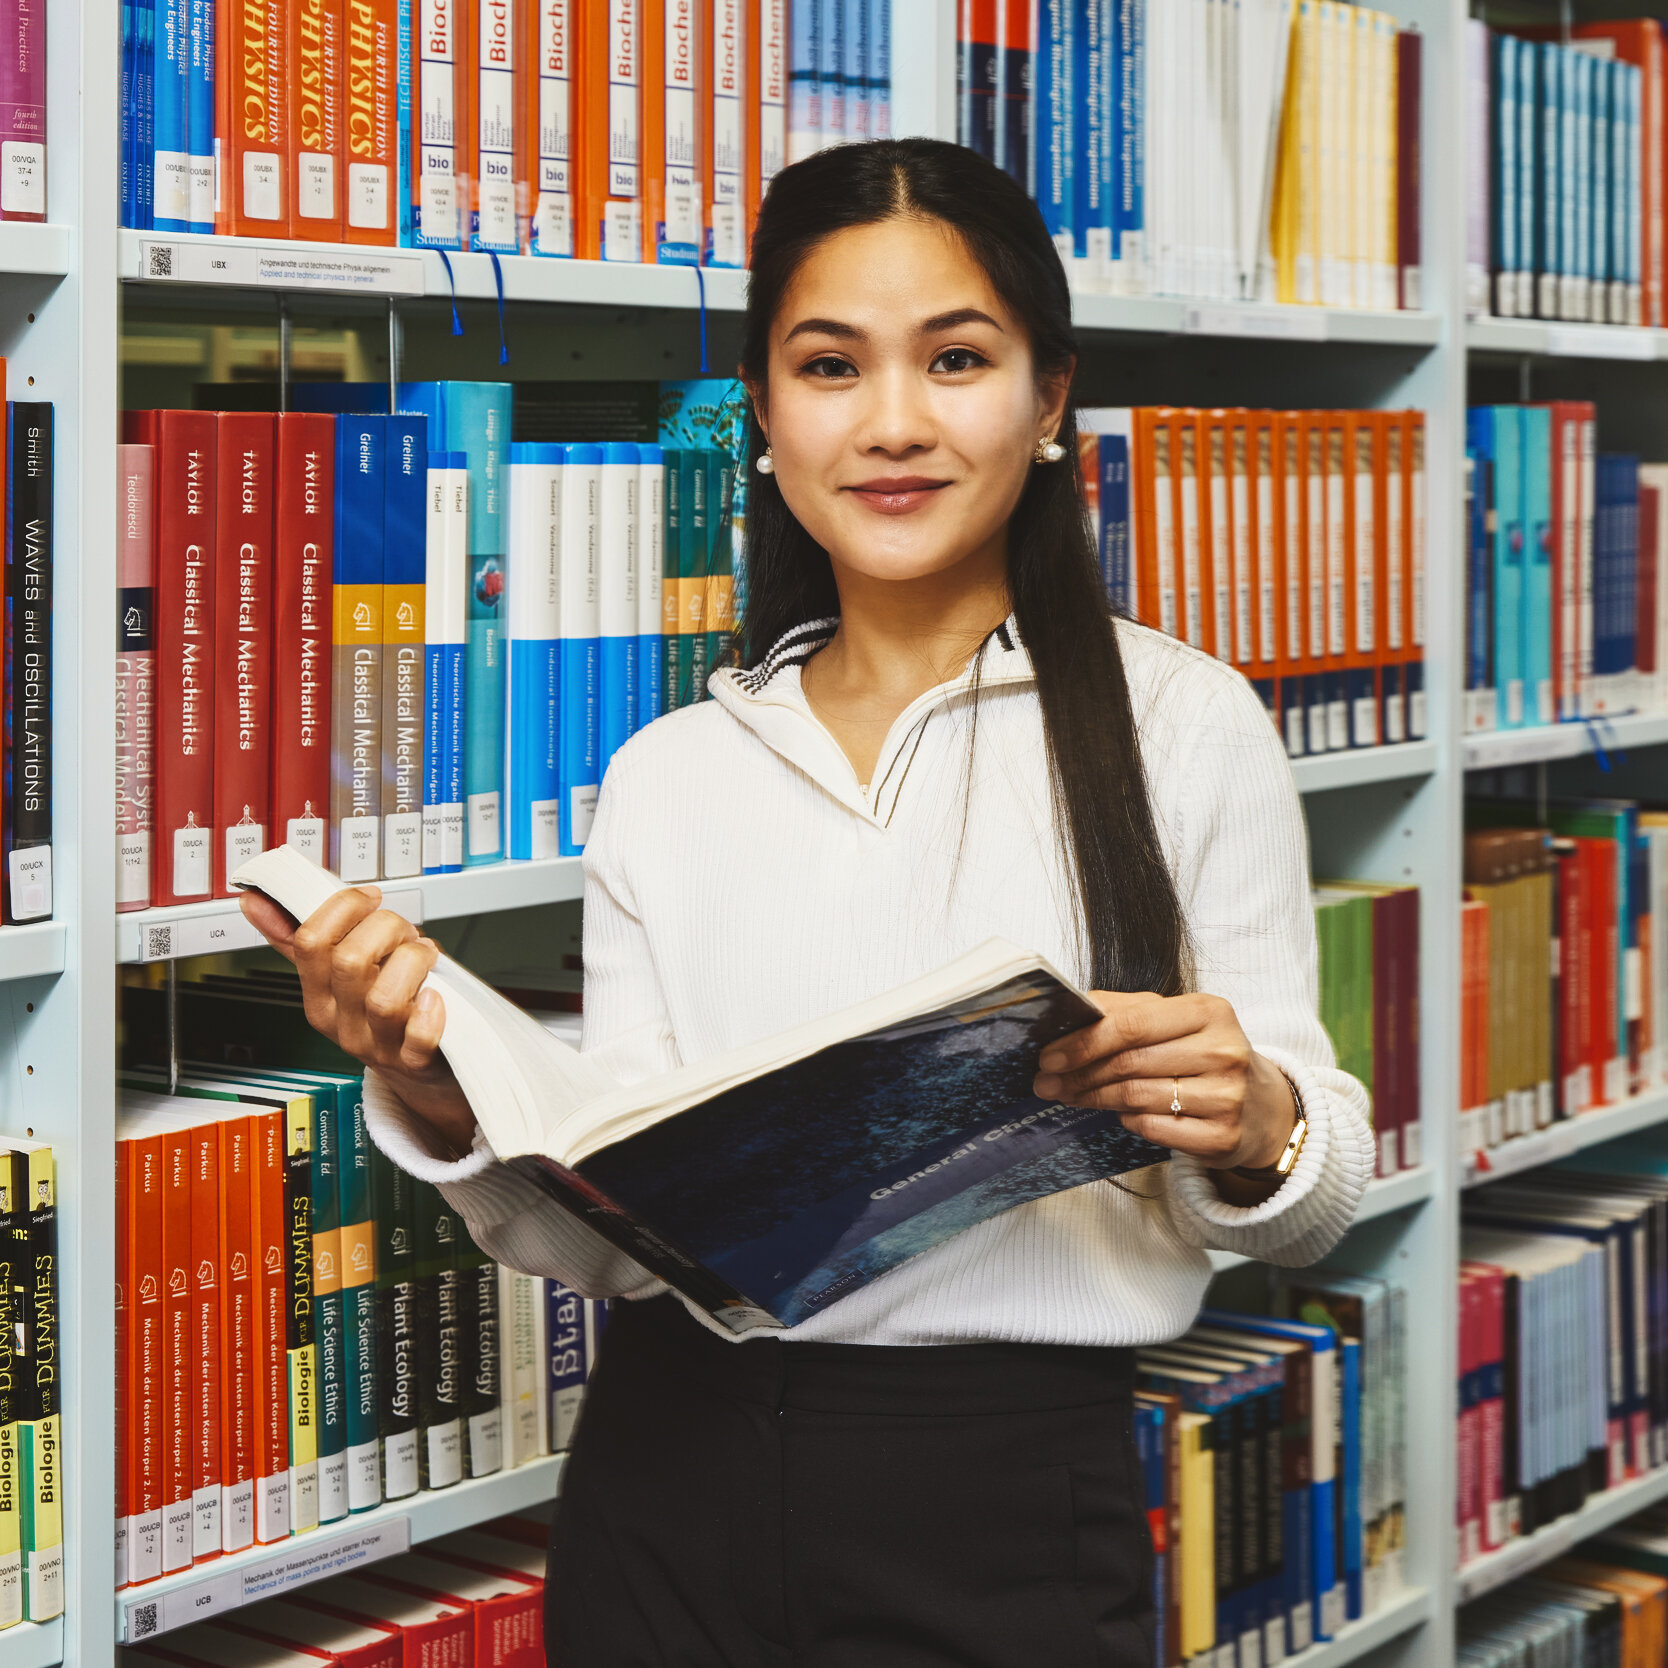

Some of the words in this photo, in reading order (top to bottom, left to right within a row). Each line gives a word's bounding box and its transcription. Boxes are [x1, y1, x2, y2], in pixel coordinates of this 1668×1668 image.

[19, 16, 28, 72] Practices
[166, 10, 174, 60] Engineers
[192, 18, 202, 66] Engineers
[268, 1, 277, 71] FOURTH
[324, 11, 334, 80] FOURTH
[376, 21, 386, 89] FOURTH
[548, 0, 562, 70] Bioch
[244, 0, 265, 143] HYSICS
[301, 0, 322, 150] PHYSICS
[350, 0, 372, 158] PHYSICS
[400, 22, 410, 111] TECHNISCHE
[14, 108, 36, 119] fourth
[14, 120, 38, 130] edition
[268, 75, 278, 146] EDITION
[324, 84, 334, 153] EDITION
[376, 93, 386, 160] EDITION
[12, 156, 36, 164] 00/VQA
[428, 155, 448, 168] bio
[487, 162, 508, 174] bio
[546, 168, 564, 181] bio
[212, 261, 226, 269] UBX
[260, 258, 298, 268] Angewandte
[310, 261, 342, 270] technische
[344, 263, 362, 273] Physik
[260, 269, 282, 280] Applied
[28, 427, 38, 477] Smith
[360, 433, 370, 474] Greiner
[403, 435, 414, 475] Greiner
[128, 474, 138, 539] Teodorescu
[188, 450, 198, 514] TAYLOR
[242, 450, 252, 514] TAYLOR
[305, 452, 314, 514] TAYLOR
[26, 520, 38, 600] WAVES
[302, 543, 318, 630] Classical
[184, 545, 200, 634] Classical
[239, 543, 254, 632] Classical
[25, 610, 37, 644] and
[116, 658, 131, 747] Classical
[182, 643, 198, 755] Mechanics
[238, 640, 254, 750] Mechanics
[301, 638, 316, 747] Mechanics
[354, 649, 372, 724] Classical
[397, 648, 414, 722] Classical
[25, 653, 38, 812] OSCILLATIONS
[136, 658, 149, 778] Mechanical
[353, 730, 371, 817] Mechanic
[396, 728, 414, 812] Mechanic
[432, 757, 436, 766] in
[115, 755, 131, 832] Models
[20, 860, 44, 871] 00/UCX
[236, 836, 256, 845] 00/UCA
[210, 930, 226, 938] UCA
[320, 1110, 328, 1156] Comstock
[354, 1103, 362, 1148] Comstock
[869, 1142, 978, 1201] General
[982, 1103, 1070, 1142] Chem
[321, 1162, 330, 1176] Ed.
[356, 1155, 364, 1168] Ed.
[32, 1212, 54, 1224] Siegfried
[292, 1196, 310, 1318] DUMMIES
[323, 1299, 335, 1324] Life
[358, 1289, 369, 1316] Life
[394, 1282, 408, 1336] Plant
[439, 1270, 452, 1323] Plant
[478, 1263, 492, 1315] Plant
[34, 1254, 54, 1388] DUMMIES
[358, 1318, 370, 1370] Science
[324, 1327, 336, 1380] Science
[392, 1339, 410, 1417] Ecology
[437, 1327, 453, 1404] Ecology
[476, 1320, 493, 1395] Ecology
[298, 1350, 311, 1426] Biologie
[325, 1383, 338, 1426] Ethics
[360, 1373, 372, 1415] Ethics
[39, 1421, 55, 1504] Biologie
[173, 1430, 182, 1468] Körper
[201, 1420, 210, 1458] Körper
[0, 1430, 14, 1512] Biologie
[169, 1512, 190, 1524] 00/UCB
[196, 1500, 217, 1512] 00/UCB
[39, 1558, 61, 1572] 00/VNO
[44, 1572, 58, 1582] 2+11
[244, 1571, 274, 1584] Mechanik
[274, 1566, 284, 1576] der
[286, 1553, 328, 1572] Massenpunkte
[330, 1549, 341, 1558] und
[362, 1535, 382, 1547] Körper
[244, 1580, 278, 1595] Mechanics
[278, 1576, 285, 1585] of
[286, 1572, 301, 1582] mass
[302, 1566, 320, 1577] points
[322, 1562, 333, 1571] and
[334, 1556, 346, 1568] rigid
[348, 1550, 366, 1562] bodies
[196, 1595, 212, 1607] UCB
